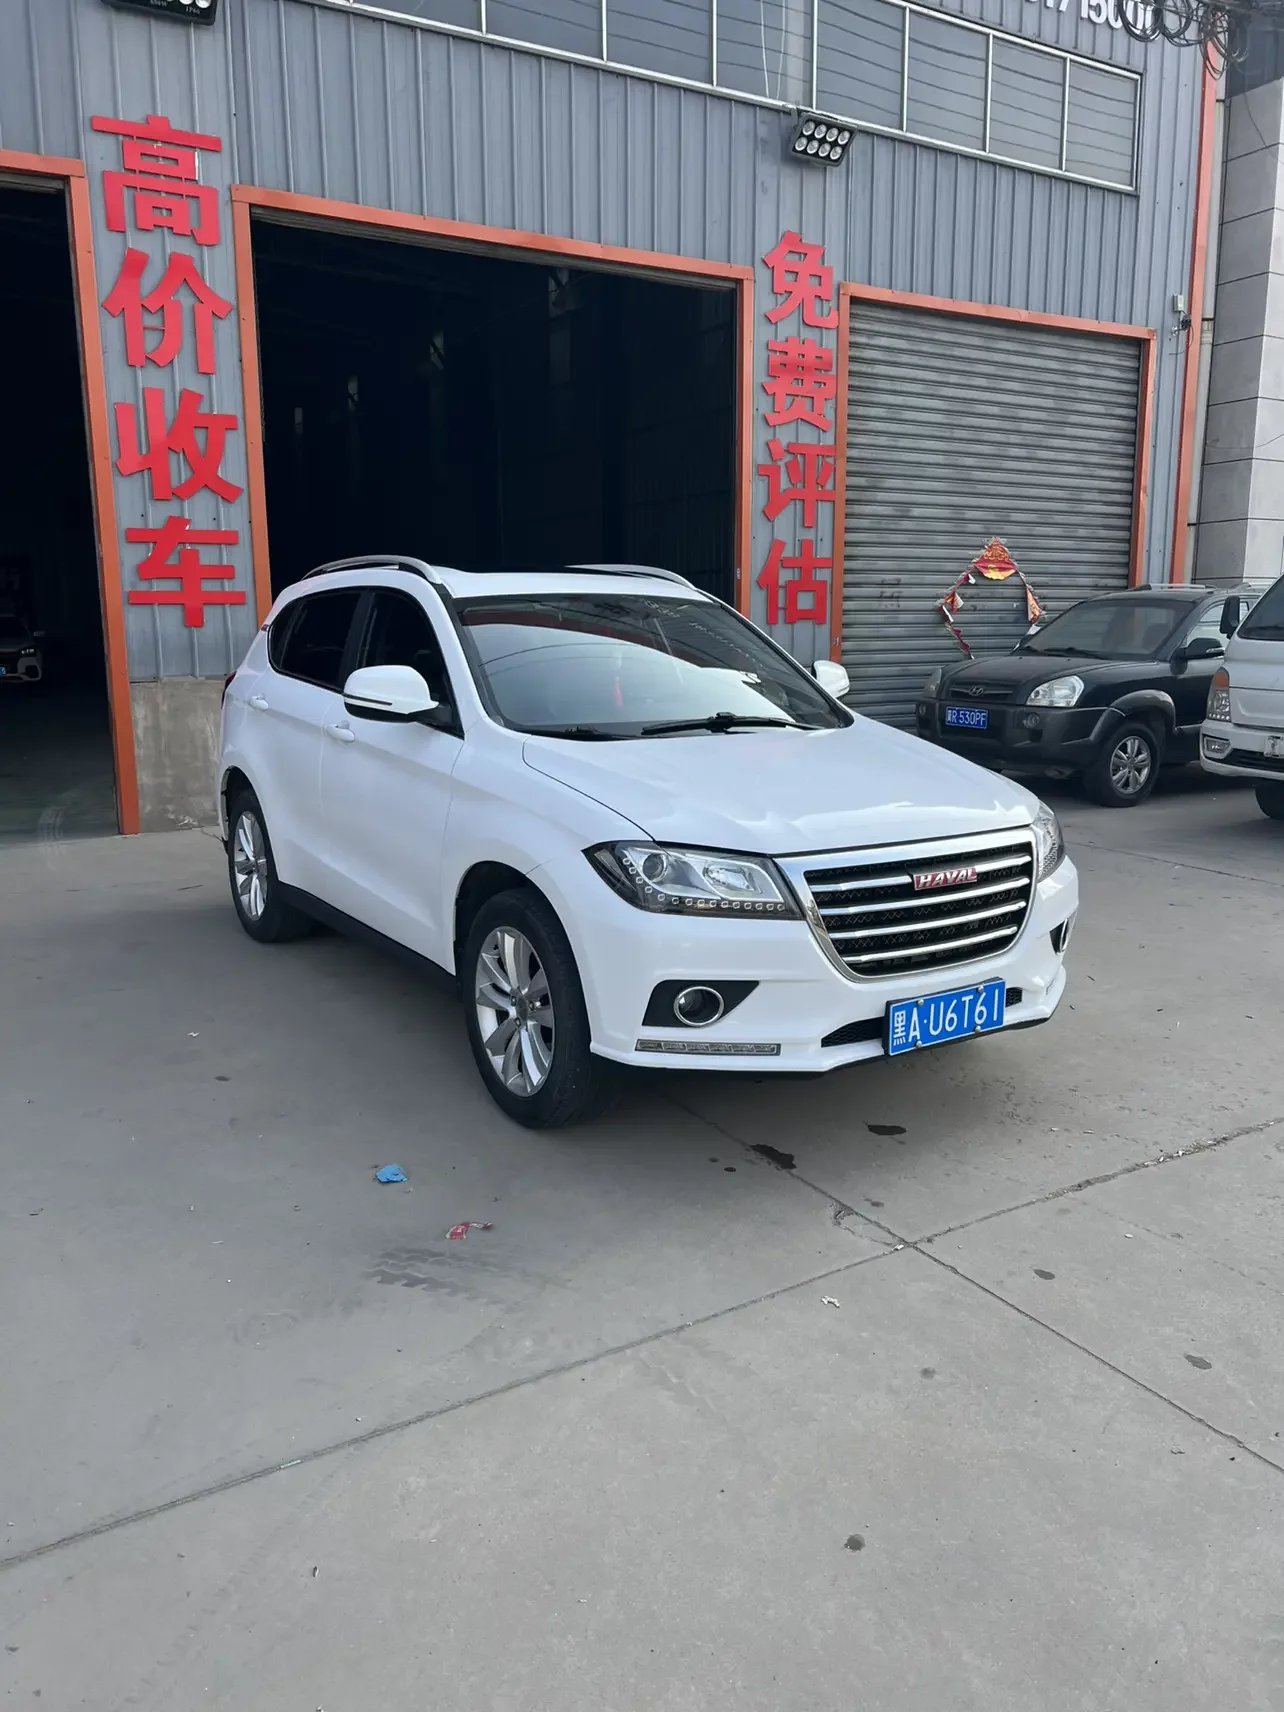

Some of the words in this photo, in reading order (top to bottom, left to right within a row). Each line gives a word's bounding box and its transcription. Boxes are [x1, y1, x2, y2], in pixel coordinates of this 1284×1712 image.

[91, 114, 246, 627] 高价收车
[757, 230, 838, 625] 免费评估
[917, 867, 977, 889] HAVAL
